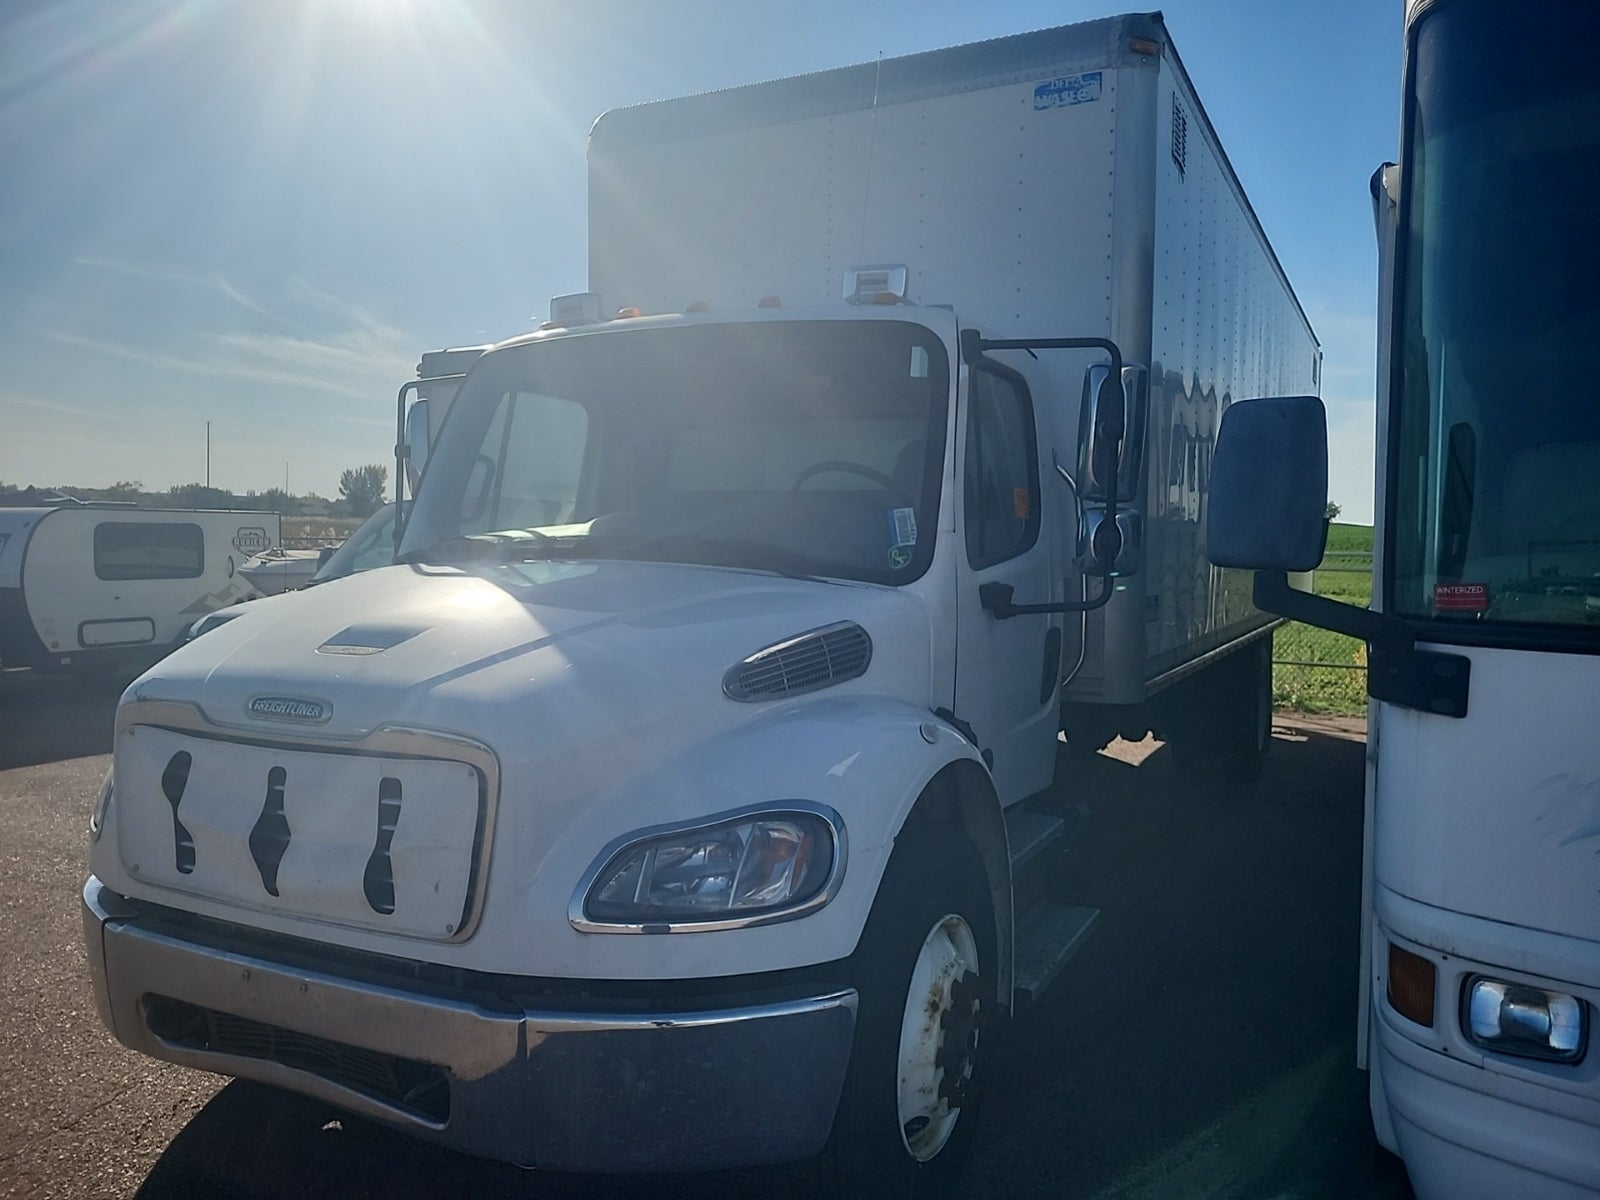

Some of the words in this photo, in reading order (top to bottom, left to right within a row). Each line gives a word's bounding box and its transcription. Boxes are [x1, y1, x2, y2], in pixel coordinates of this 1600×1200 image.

[233, 536, 271, 547] RUBICON
[1436, 585, 1483, 595] WINTERIZED
[253, 699, 321, 717] FREIGHTLINER
